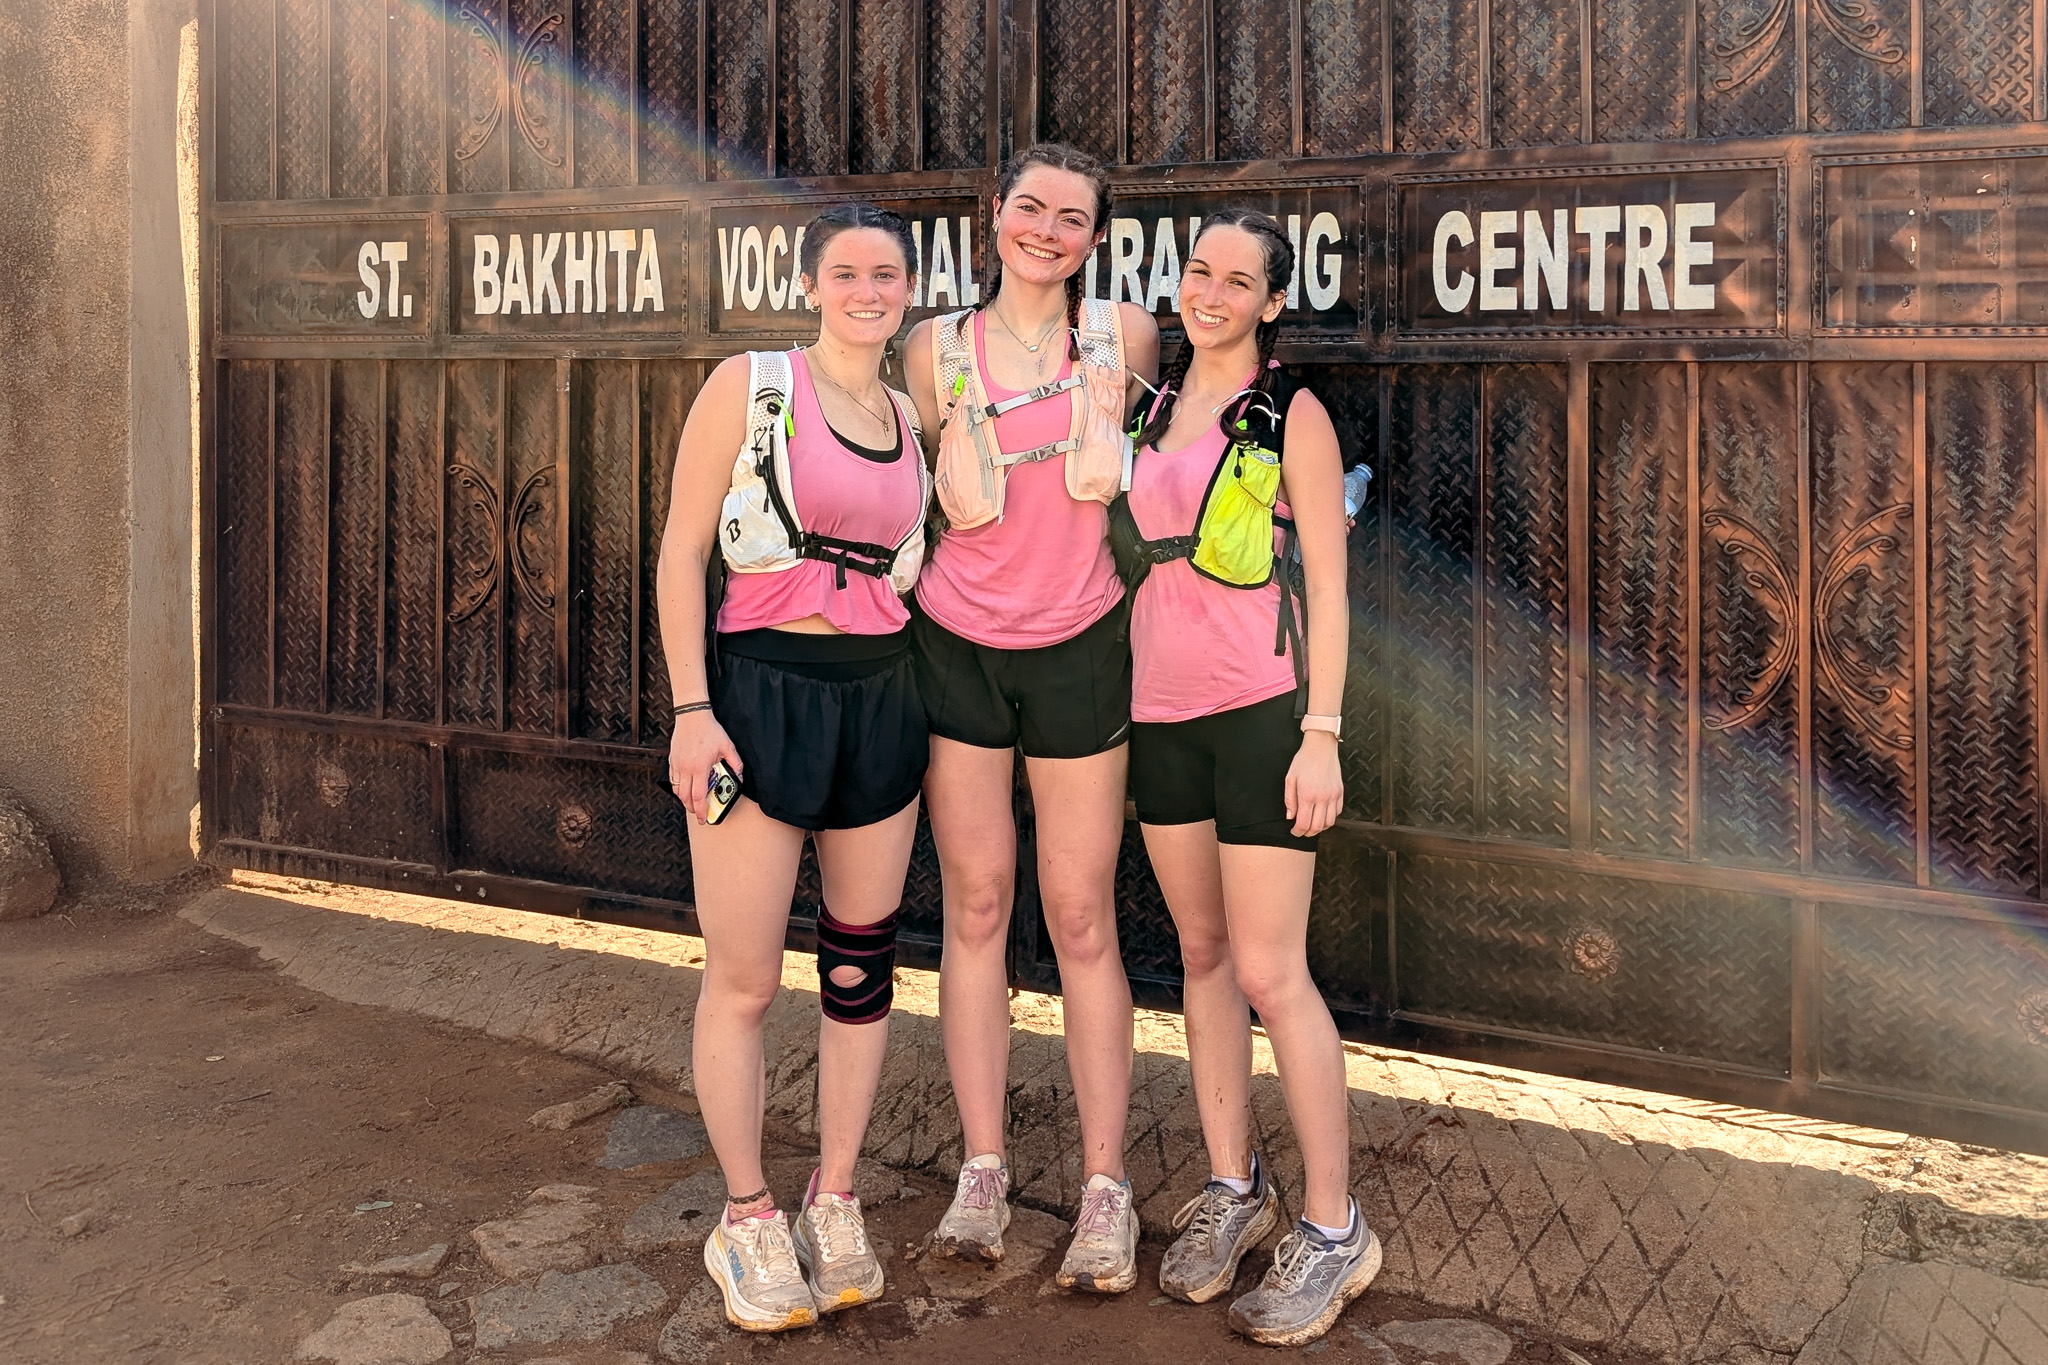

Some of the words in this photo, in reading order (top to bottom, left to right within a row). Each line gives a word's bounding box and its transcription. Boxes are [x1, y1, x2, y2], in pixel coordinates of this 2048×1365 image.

[357, 240, 412, 319] ST.
[473, 228, 664, 315] BAKHITA
[1432, 202, 1716, 313] CENTRE
